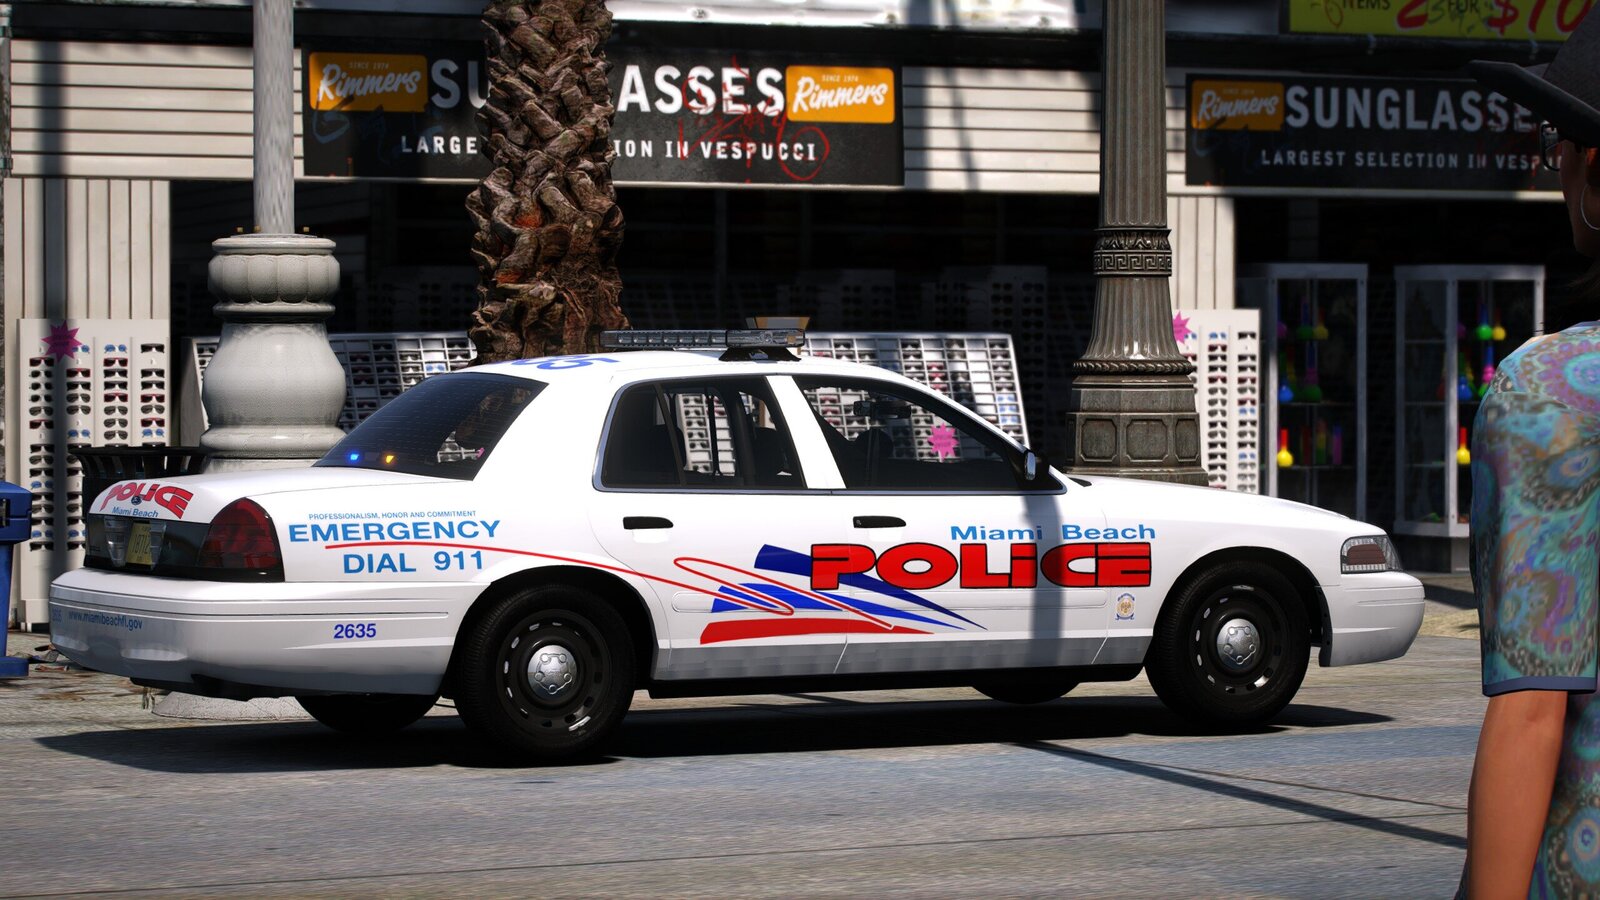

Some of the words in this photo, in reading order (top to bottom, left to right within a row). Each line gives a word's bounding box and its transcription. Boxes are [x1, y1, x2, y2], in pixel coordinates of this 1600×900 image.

[316, 64, 421, 102] Rimmers
[821, 74, 841, 82] SINCE
[792, 76, 889, 113] Rimmers
[1198, 90, 1280, 122] Rimmers
[665, 140, 689, 160] IN
[700, 141, 816, 161] VESPUCCI
[1261, 149, 1346, 166] LARGEST
[1355, 151, 1458, 169] SELECTION
[1468, 153, 1487, 169] IN
[112, 506, 131, 516] Miami
[132, 508, 159, 518] Beach
[308, 511, 381, 521] PROFESSIONALISM,
[381, 511, 409, 519] HONOR
[410, 511, 425, 519] AND
[427, 510, 477, 519] COMMITMENT
[288, 519, 501, 543] EMERGENCY
[950, 524, 1043, 541] Miami
[1062, 523, 1156, 541] Beach
[343, 552, 417, 574] DIAL
[433, 550, 483, 572] 911
[333, 622, 377, 640] 2635
